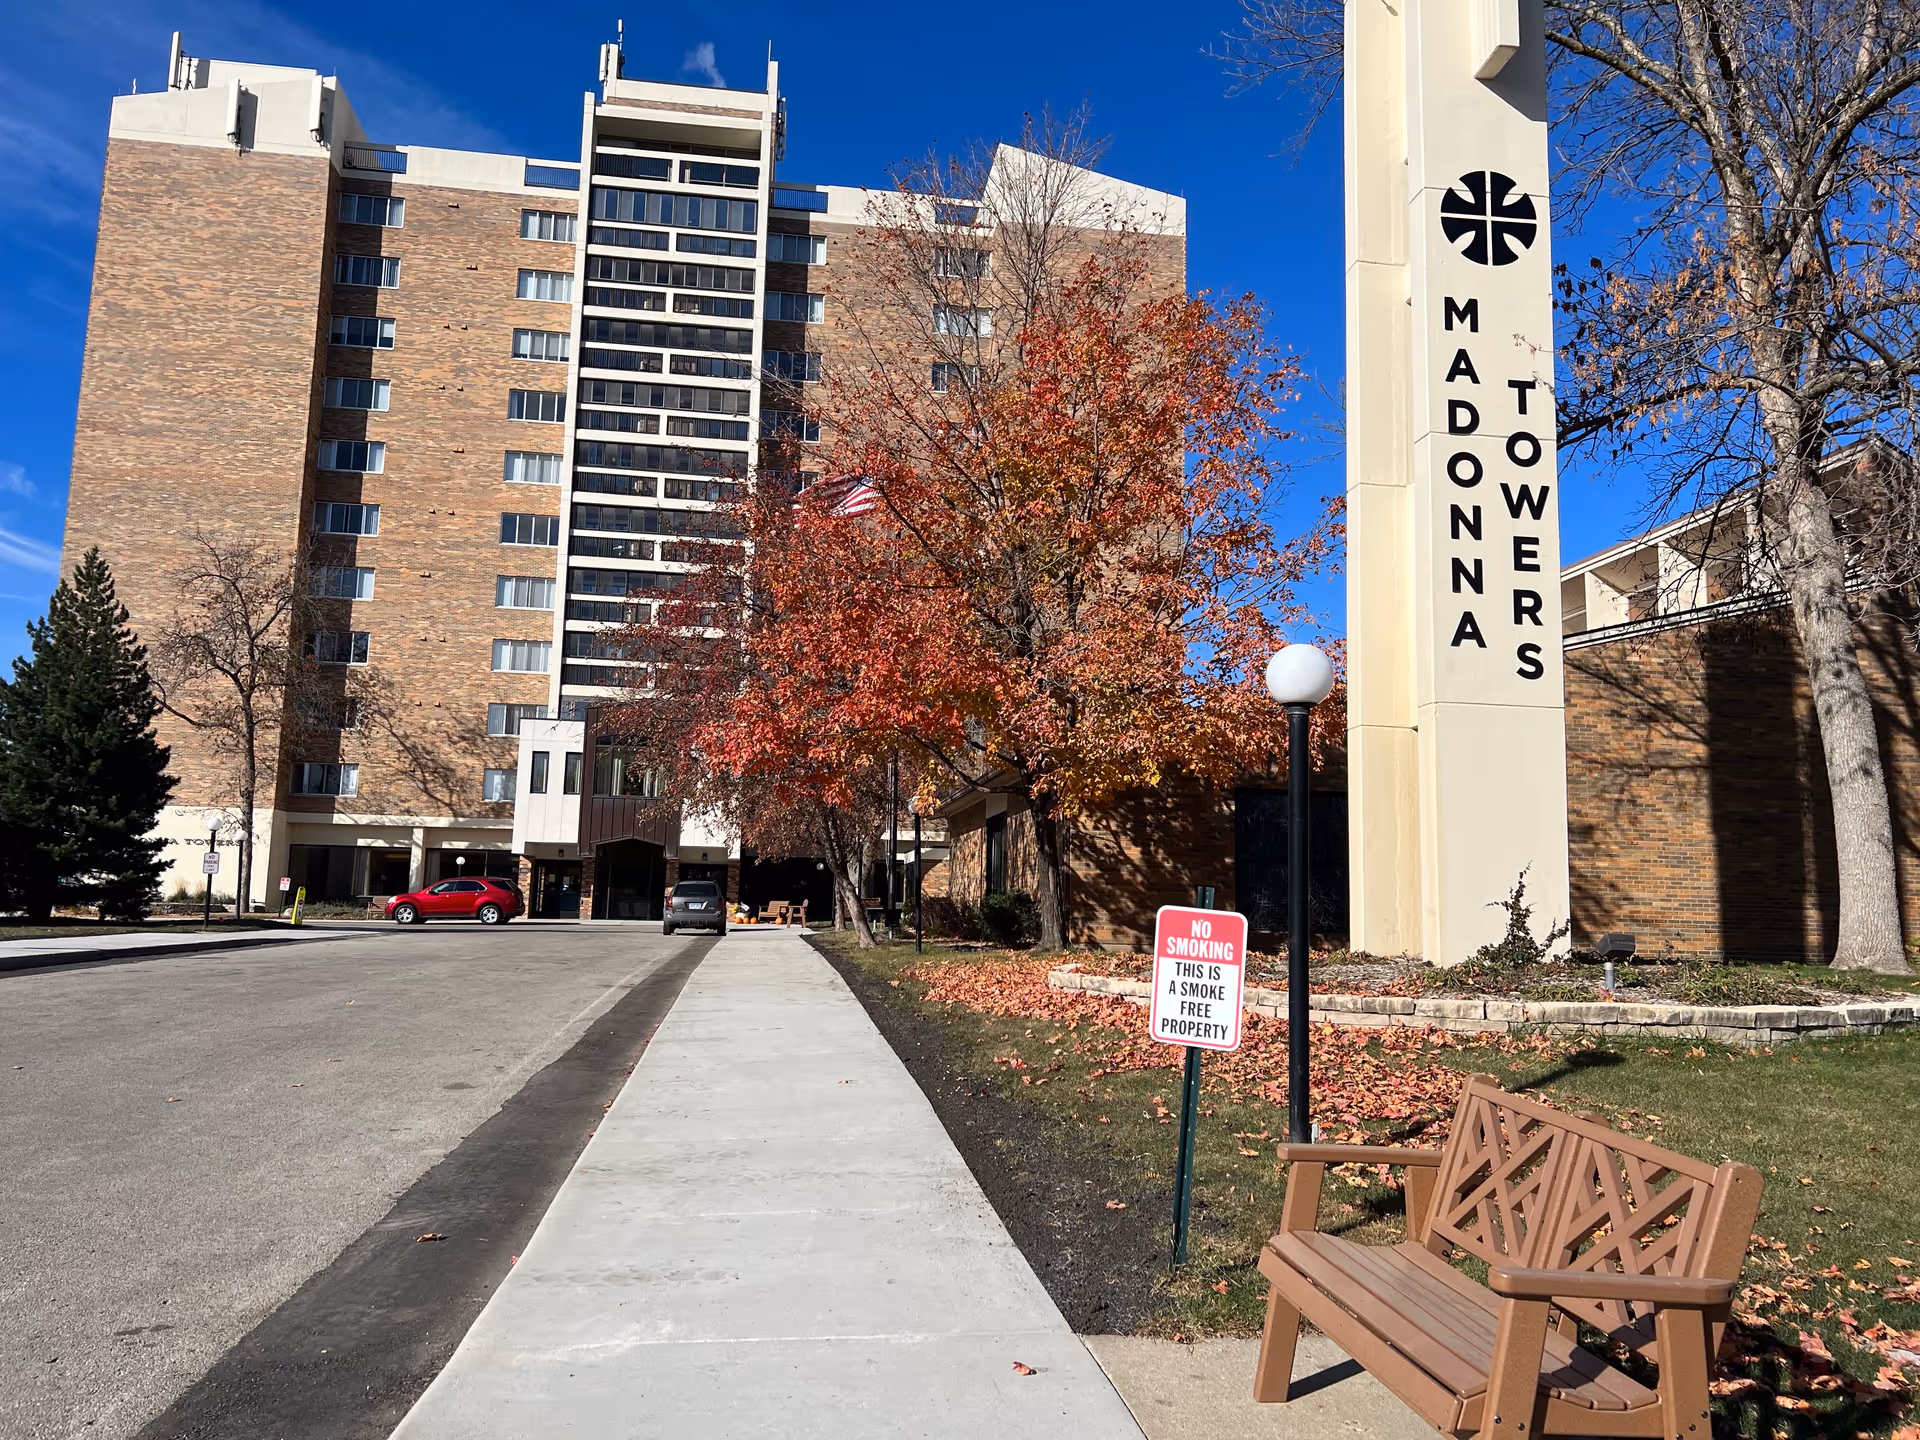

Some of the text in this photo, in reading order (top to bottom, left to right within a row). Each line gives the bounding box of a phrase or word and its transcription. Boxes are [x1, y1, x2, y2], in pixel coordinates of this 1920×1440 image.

[1444, 296, 1488, 649] MADONNA
[1500, 379, 1550, 680] TOWERS
[1191, 919, 1212, 939] NO
[1166, 936, 1234, 961] SMOKING
[1175, 961, 1221, 981] THIS IS
[1168, 980, 1225, 1001] A SMOKE
[1180, 1000, 1212, 1019] FREE
[1161, 1017, 1229, 1040] PROPERTY
